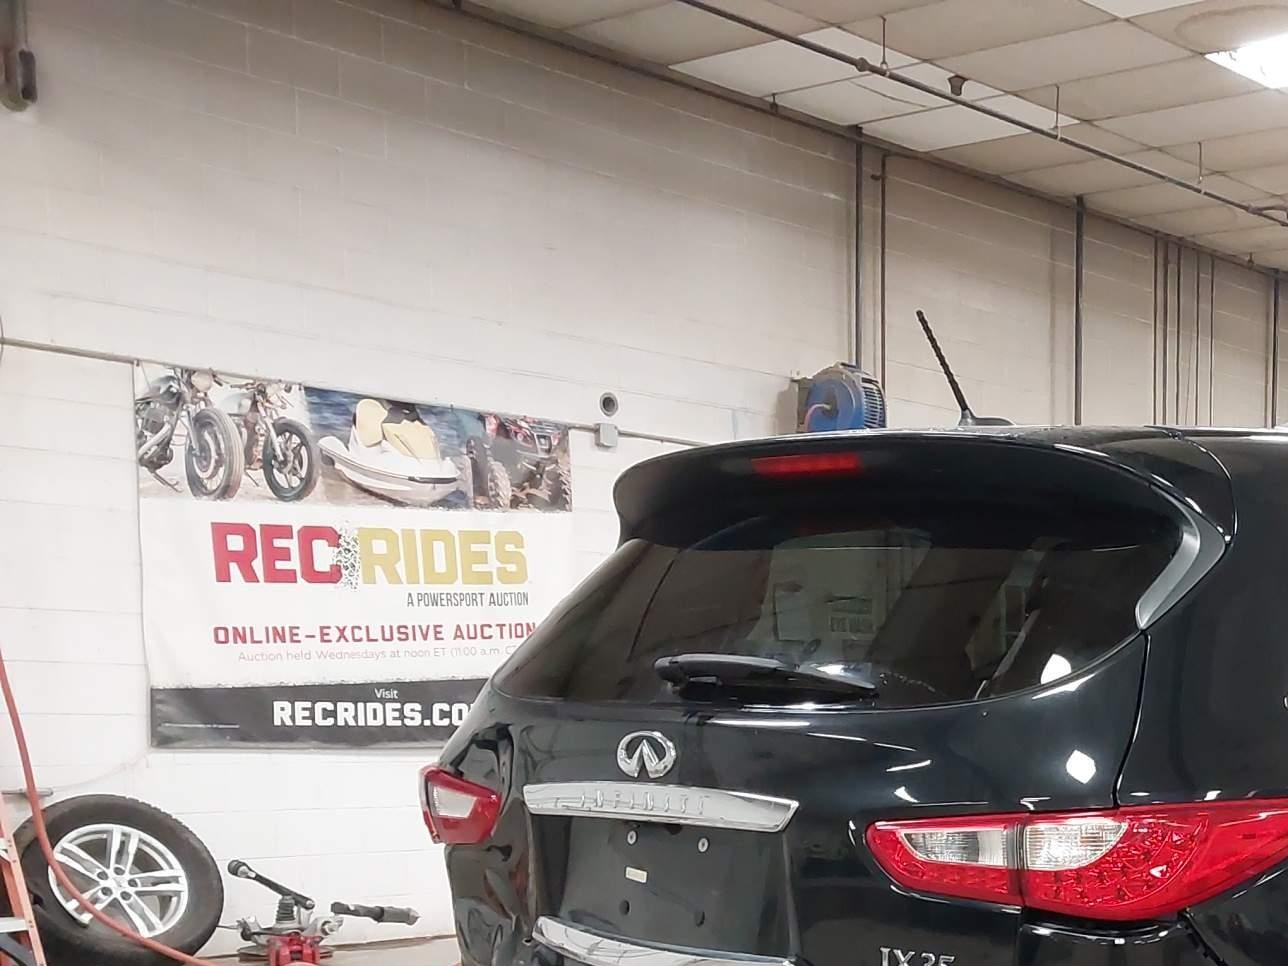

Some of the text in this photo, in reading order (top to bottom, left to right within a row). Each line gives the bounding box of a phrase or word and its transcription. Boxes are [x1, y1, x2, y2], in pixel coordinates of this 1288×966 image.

[407, 591, 529, 607] A POWERSPORT AUCTION
[213, 624, 445, 645] ONLINE-EXCLUSIVE
[238, 652, 283, 662] Auction
[286, 650, 312, 661] held
[313, 649, 387, 661] Wednesdays
[389, 649, 401, 659] at
[404, 649, 430, 658] noon
[434, 648, 447, 657] ET
[374, 687, 399, 699] Visit
[272, 700, 474, 727] RECRIDES.CO
